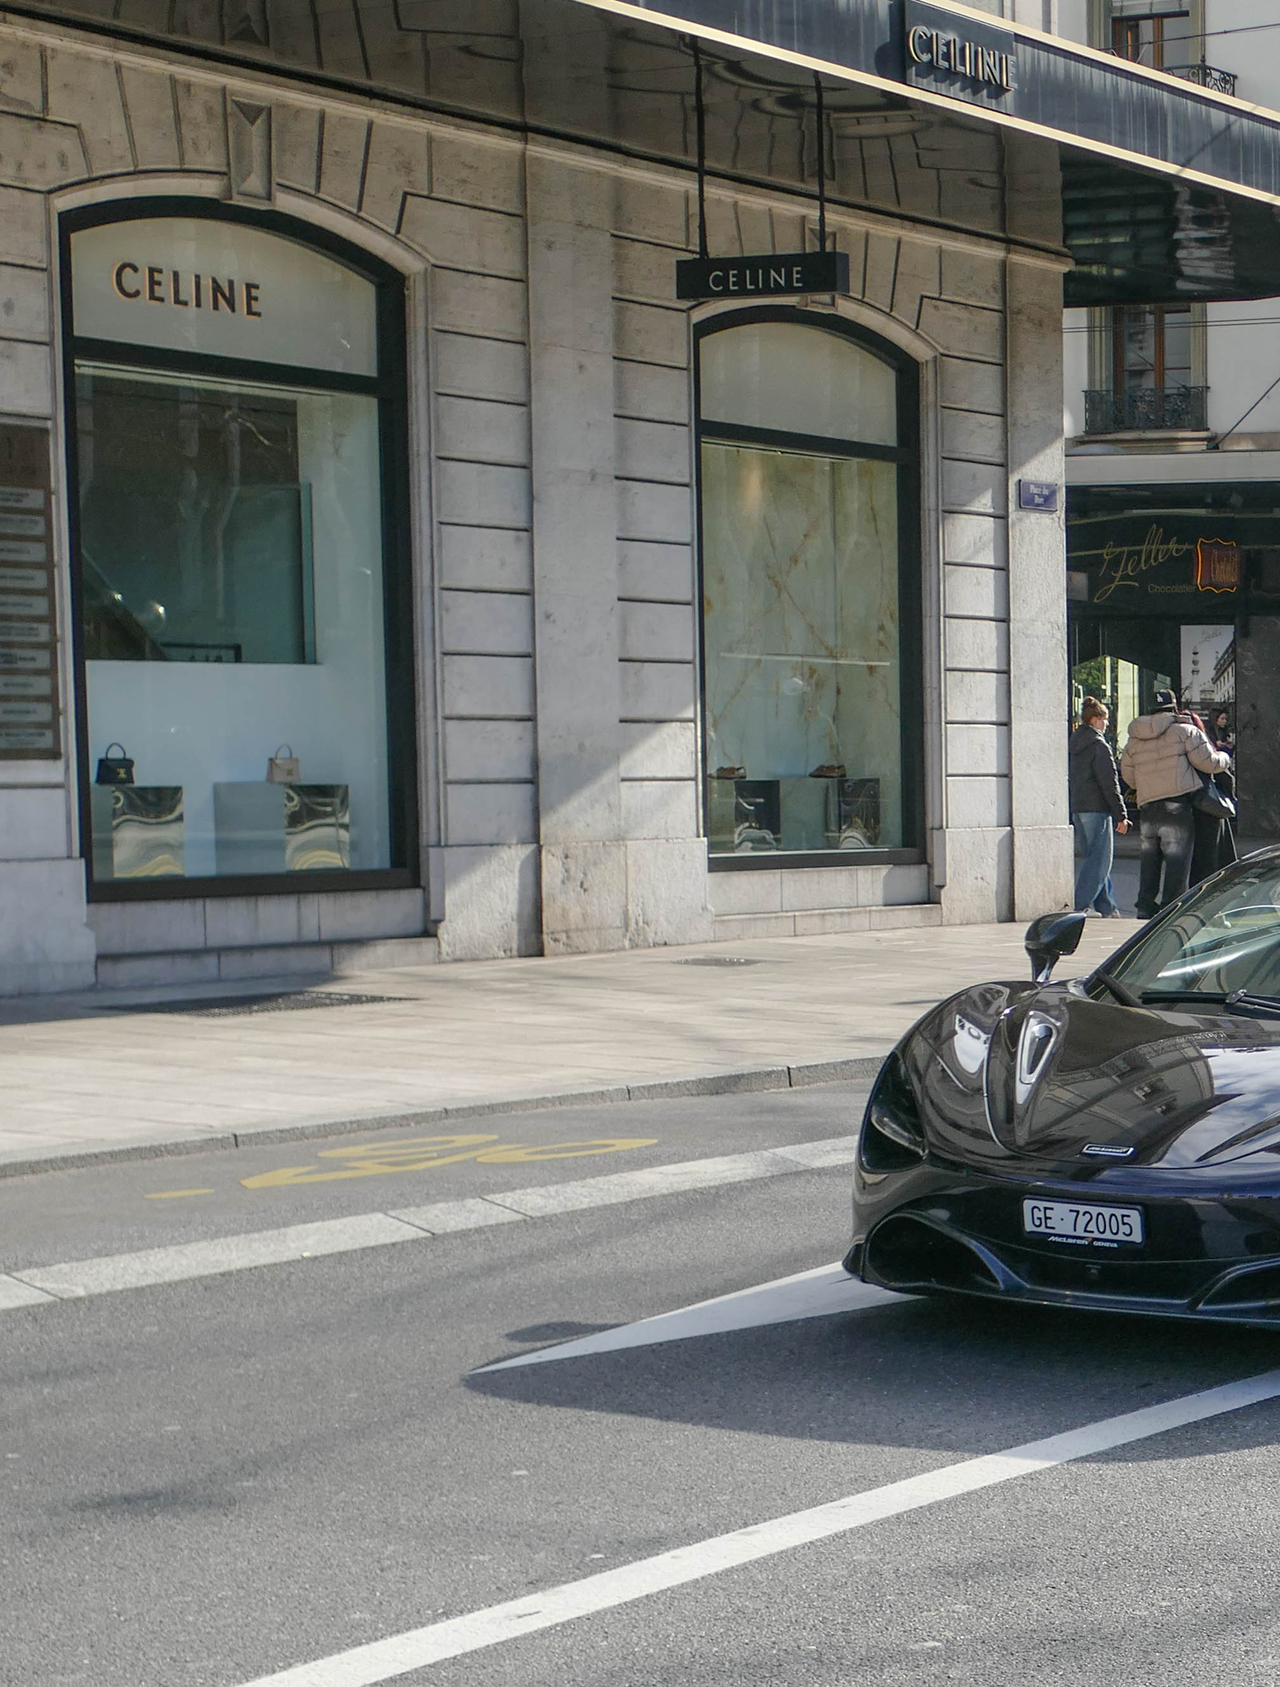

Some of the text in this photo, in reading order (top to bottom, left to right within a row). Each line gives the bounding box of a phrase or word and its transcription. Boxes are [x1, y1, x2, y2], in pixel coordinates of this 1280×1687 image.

[908, 25, 1018, 91] CELINE
[112, 261, 262, 317] CELINE
[709, 266, 803, 291] CELINE
[1031, 1205, 1134, 1237] GE 72005
[1048, 1235, 1089, 1245] McLaren
